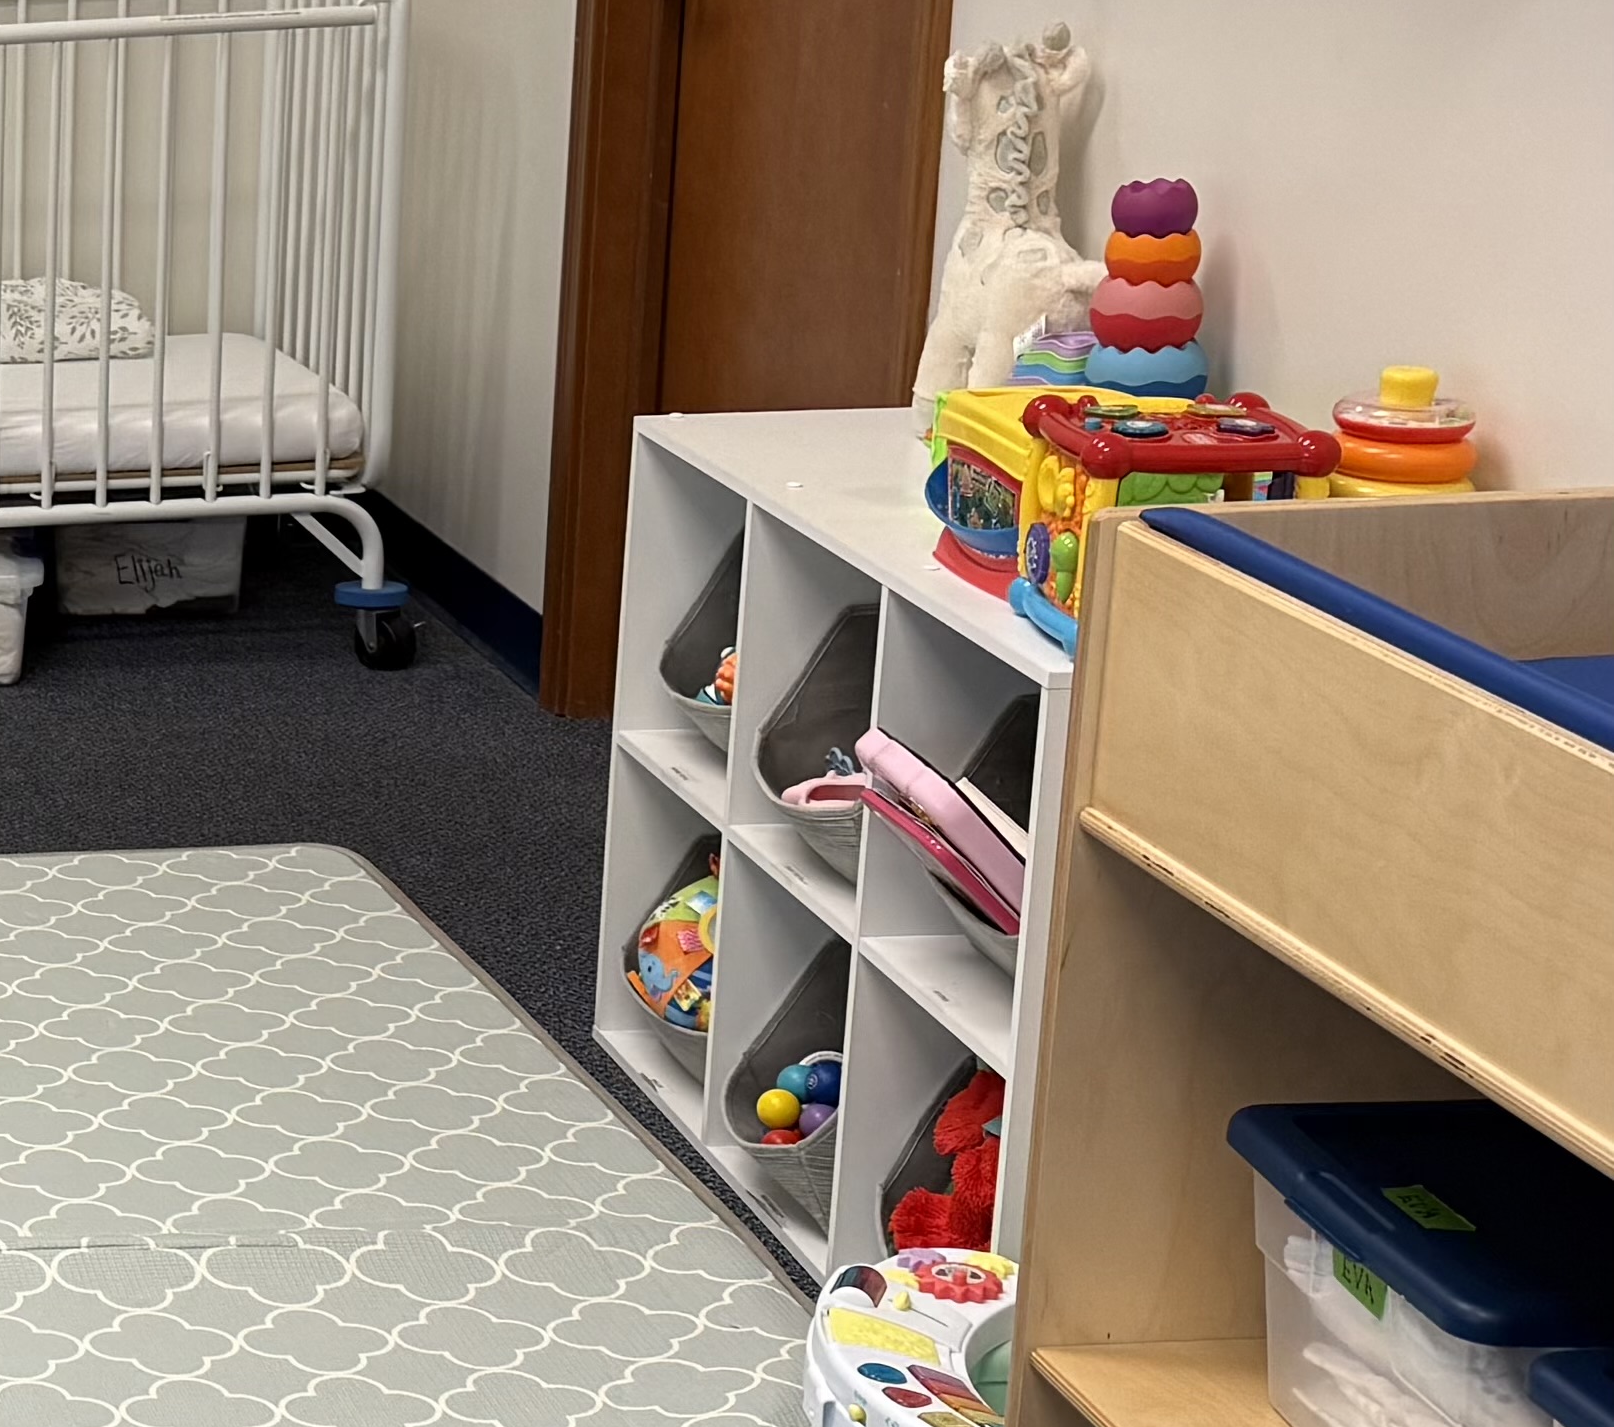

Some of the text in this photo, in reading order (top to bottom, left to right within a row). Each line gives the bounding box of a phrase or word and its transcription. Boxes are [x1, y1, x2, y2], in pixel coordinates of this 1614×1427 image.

[114, 554, 183, 594] Elijah
[1397, 1194, 1441, 1219] EVA
[1342, 1255, 1374, 1304] EVA
